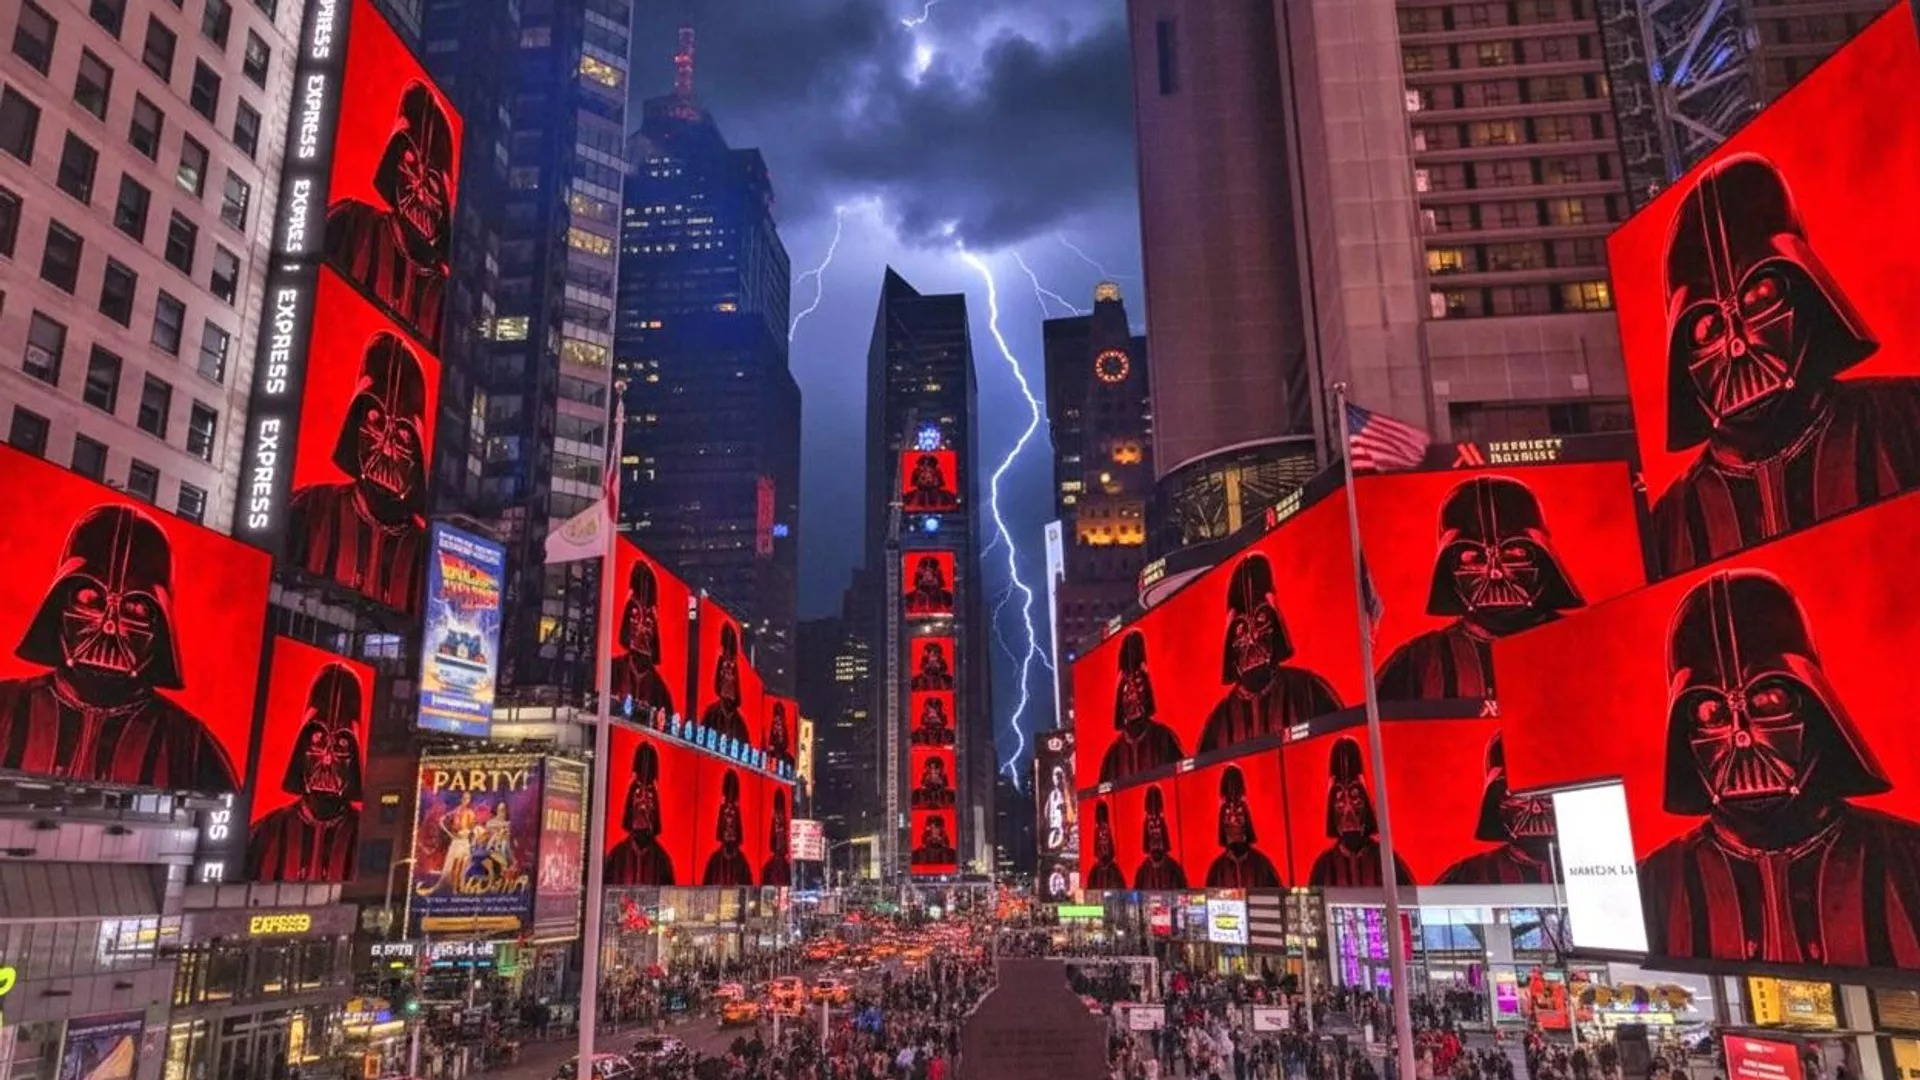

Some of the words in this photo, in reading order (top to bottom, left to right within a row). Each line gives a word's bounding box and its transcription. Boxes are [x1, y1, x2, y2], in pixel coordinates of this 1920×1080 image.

[265, 288, 297, 394] EXPRESS
[248, 418, 281, 529] EXPRESS
[432, 770, 529, 796] PARTY!
